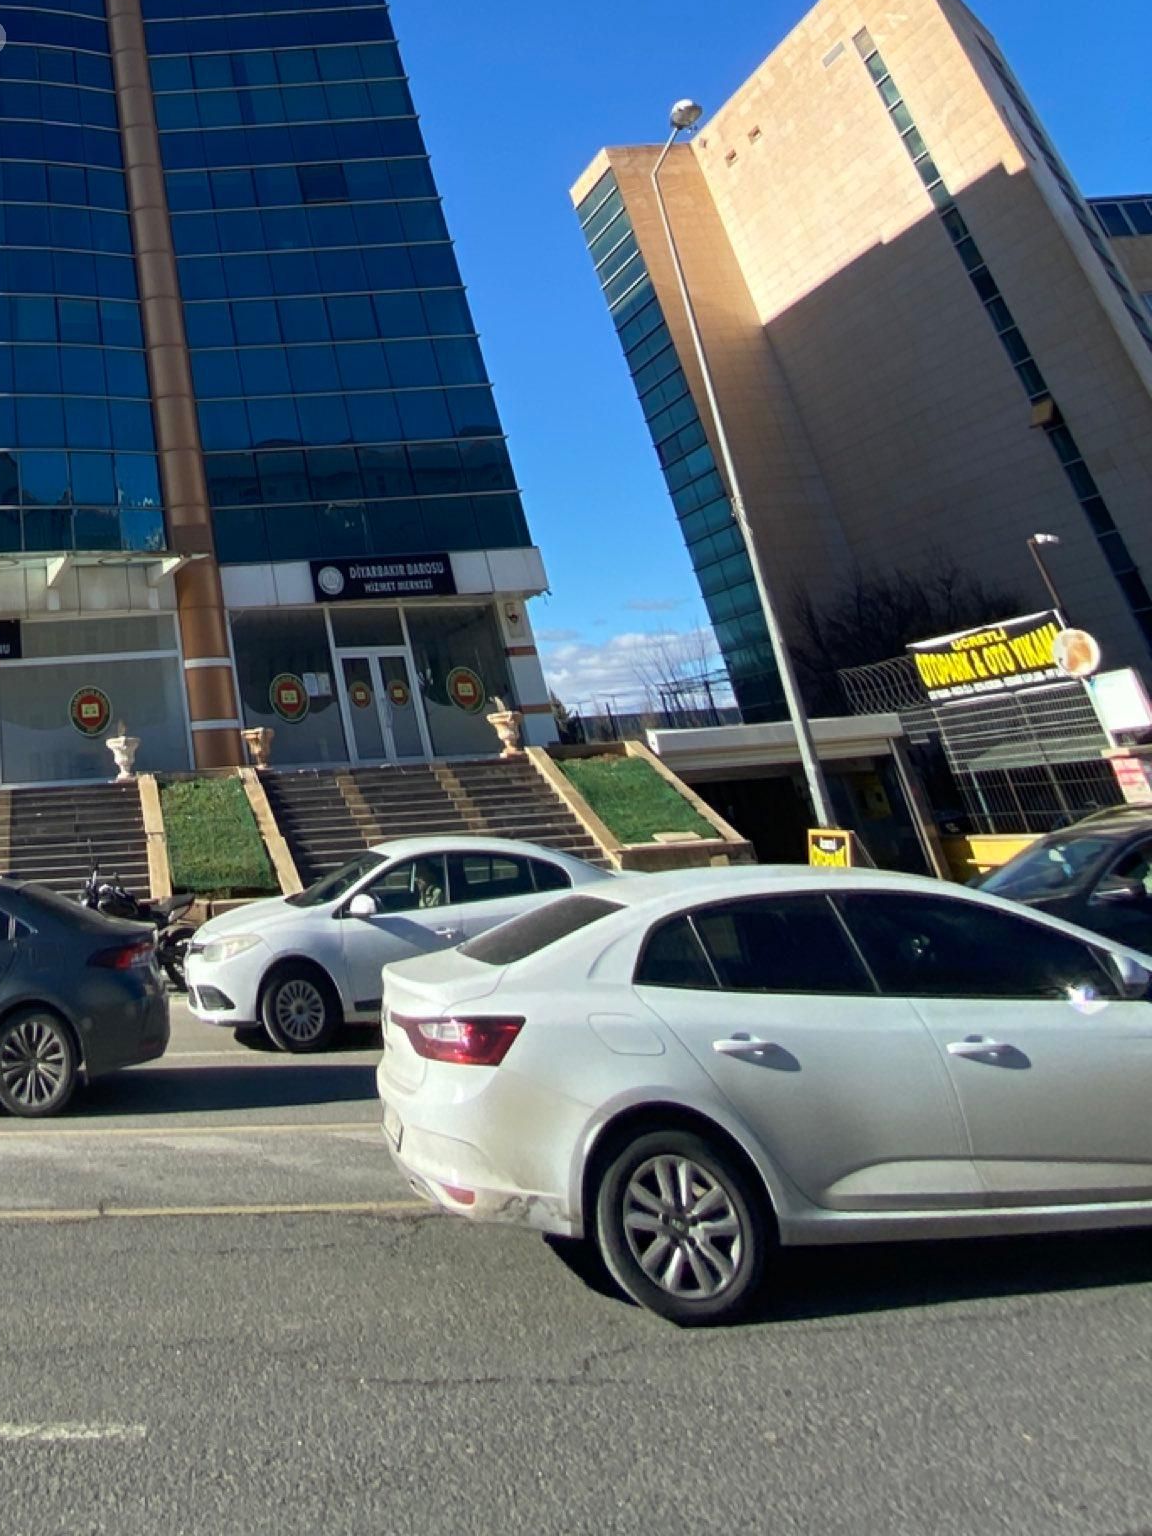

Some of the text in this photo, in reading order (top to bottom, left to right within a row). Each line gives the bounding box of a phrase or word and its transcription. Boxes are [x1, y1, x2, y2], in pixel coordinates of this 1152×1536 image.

[406, 561, 444, 575] BAROSU
[914, 651, 977, 688] OTOPARK
[982, 642, 1017, 675] OTO
